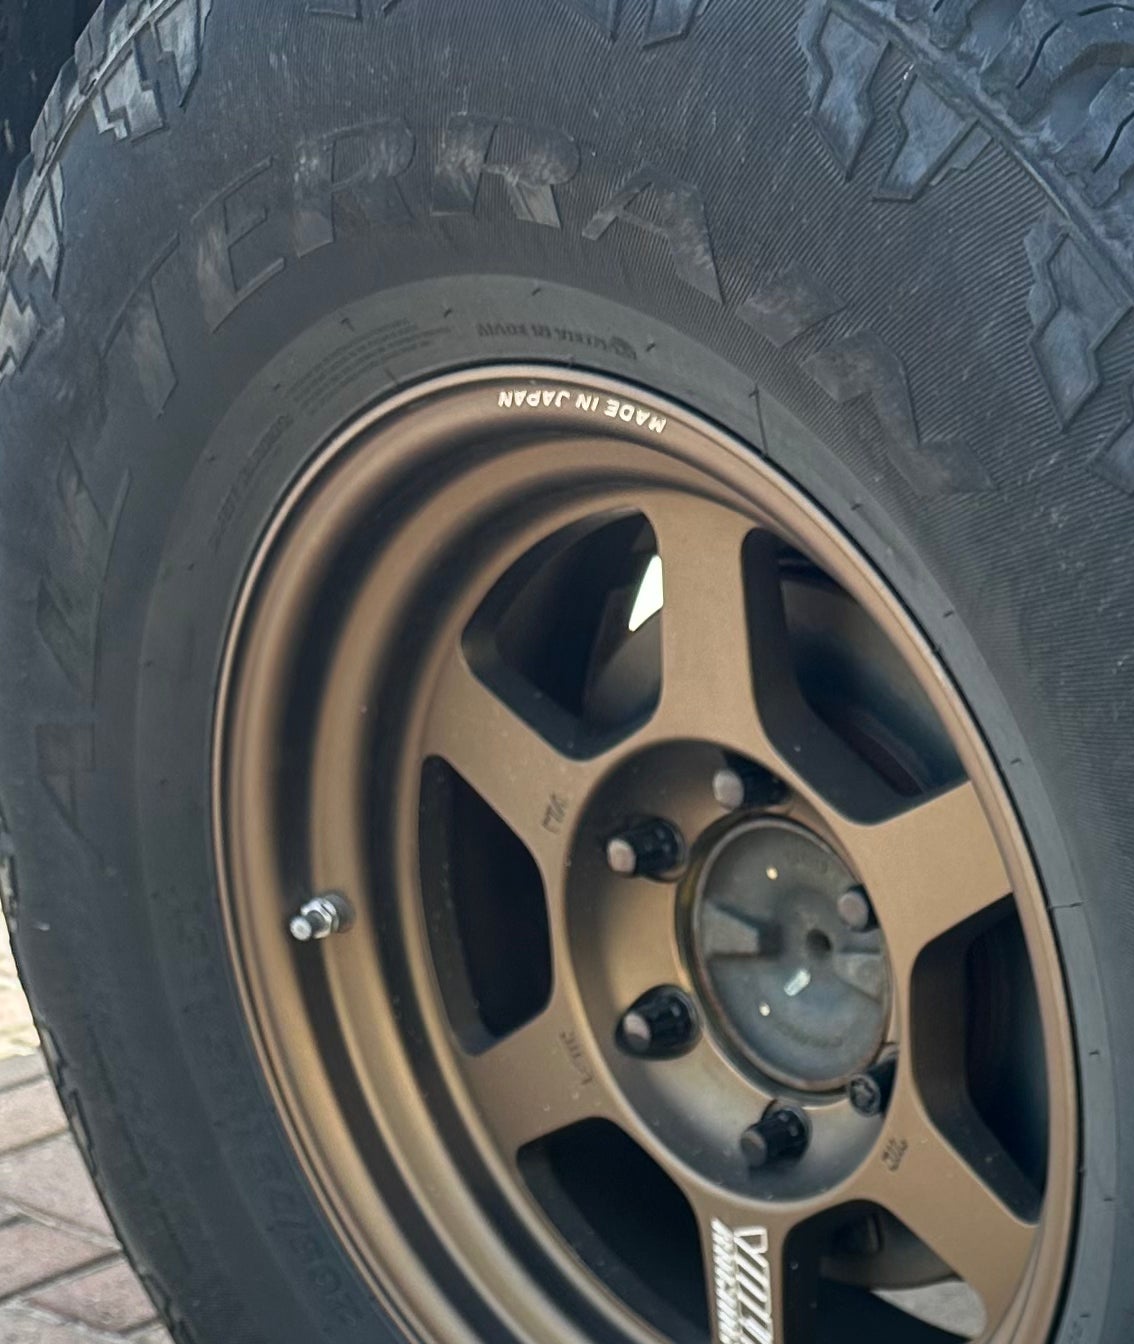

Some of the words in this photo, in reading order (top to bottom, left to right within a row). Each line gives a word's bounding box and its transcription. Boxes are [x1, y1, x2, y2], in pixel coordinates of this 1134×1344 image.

[498, 389, 571, 408] JAPAN
[575, 393, 600, 412] IN
[604, 398, 667, 433] MADE
